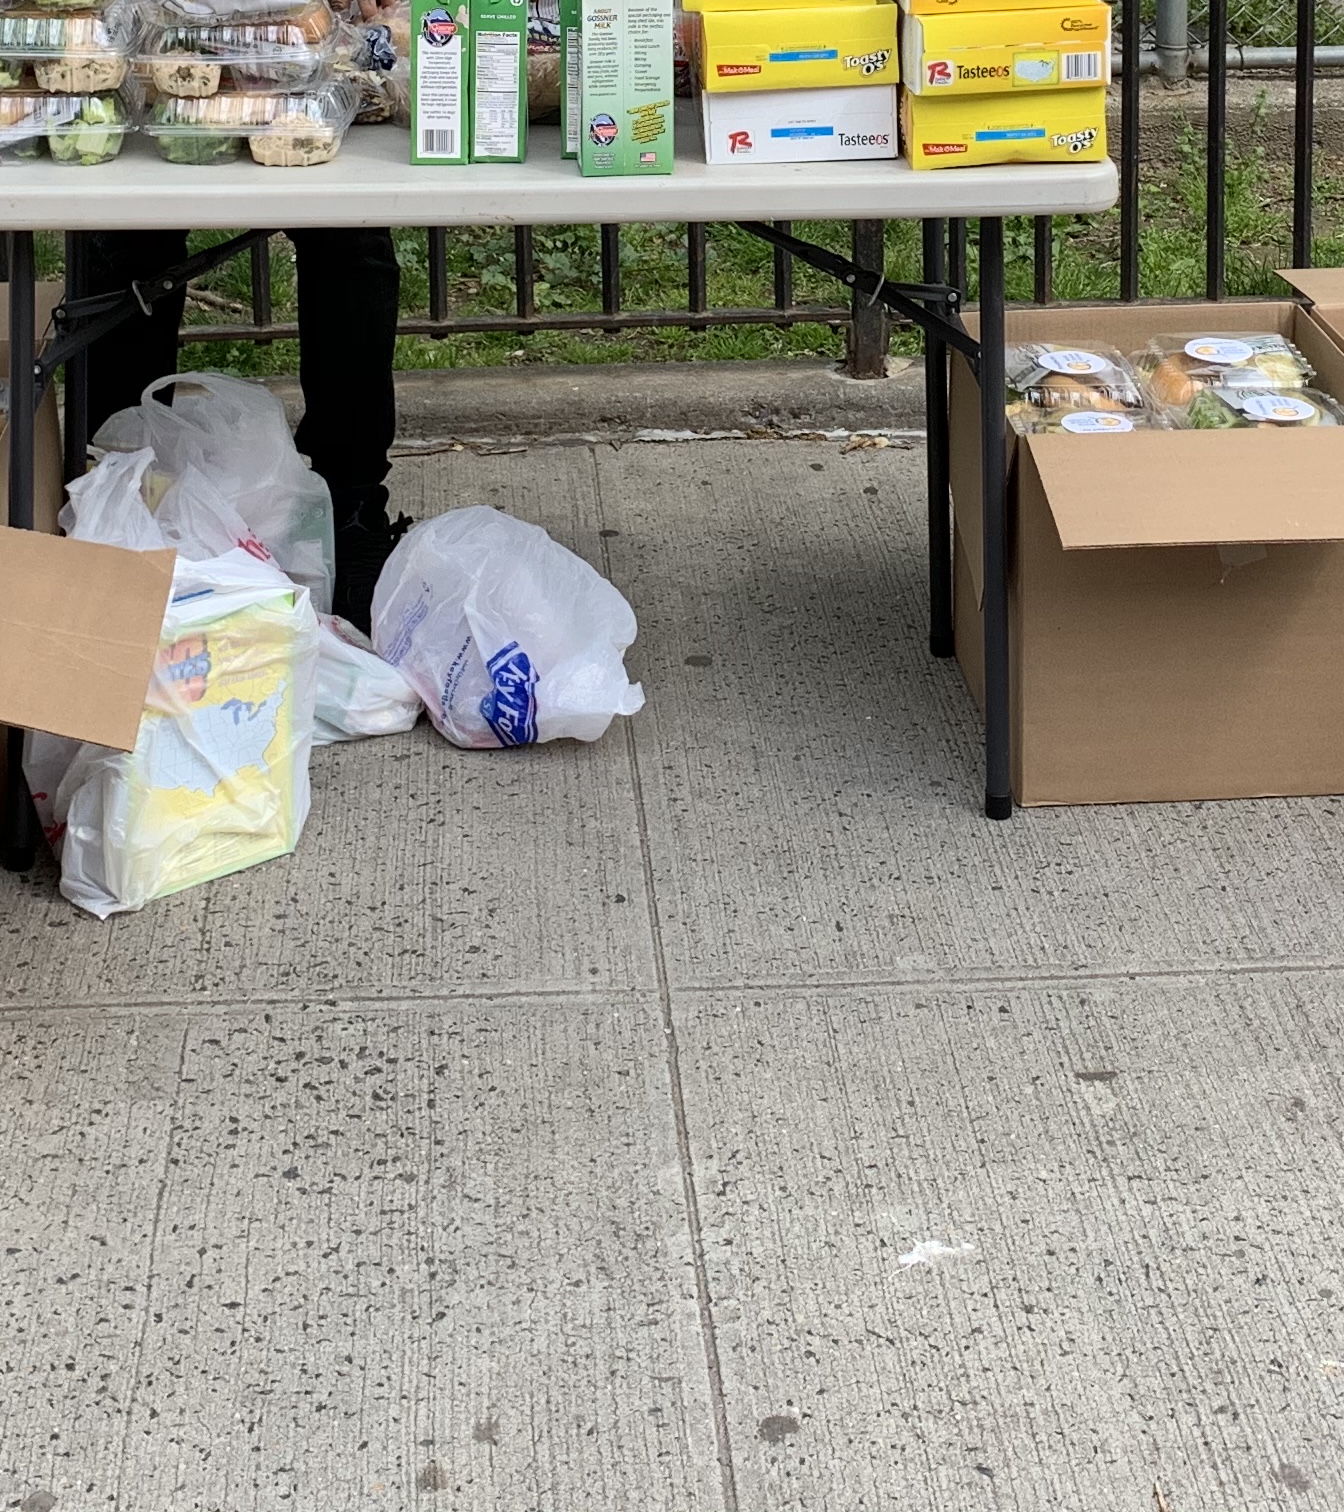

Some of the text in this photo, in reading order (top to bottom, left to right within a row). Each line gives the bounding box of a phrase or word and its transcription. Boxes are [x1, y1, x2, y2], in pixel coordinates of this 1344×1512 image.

[843, 49, 892, 68] Toasty
[862, 60, 884, 76] O's
[957, 64, 1011, 79] Tasteeos
[838, 133, 889, 147] Tasteeos
[1051, 126, 1099, 147] Toasty
[1069, 139, 1092, 154] O's
